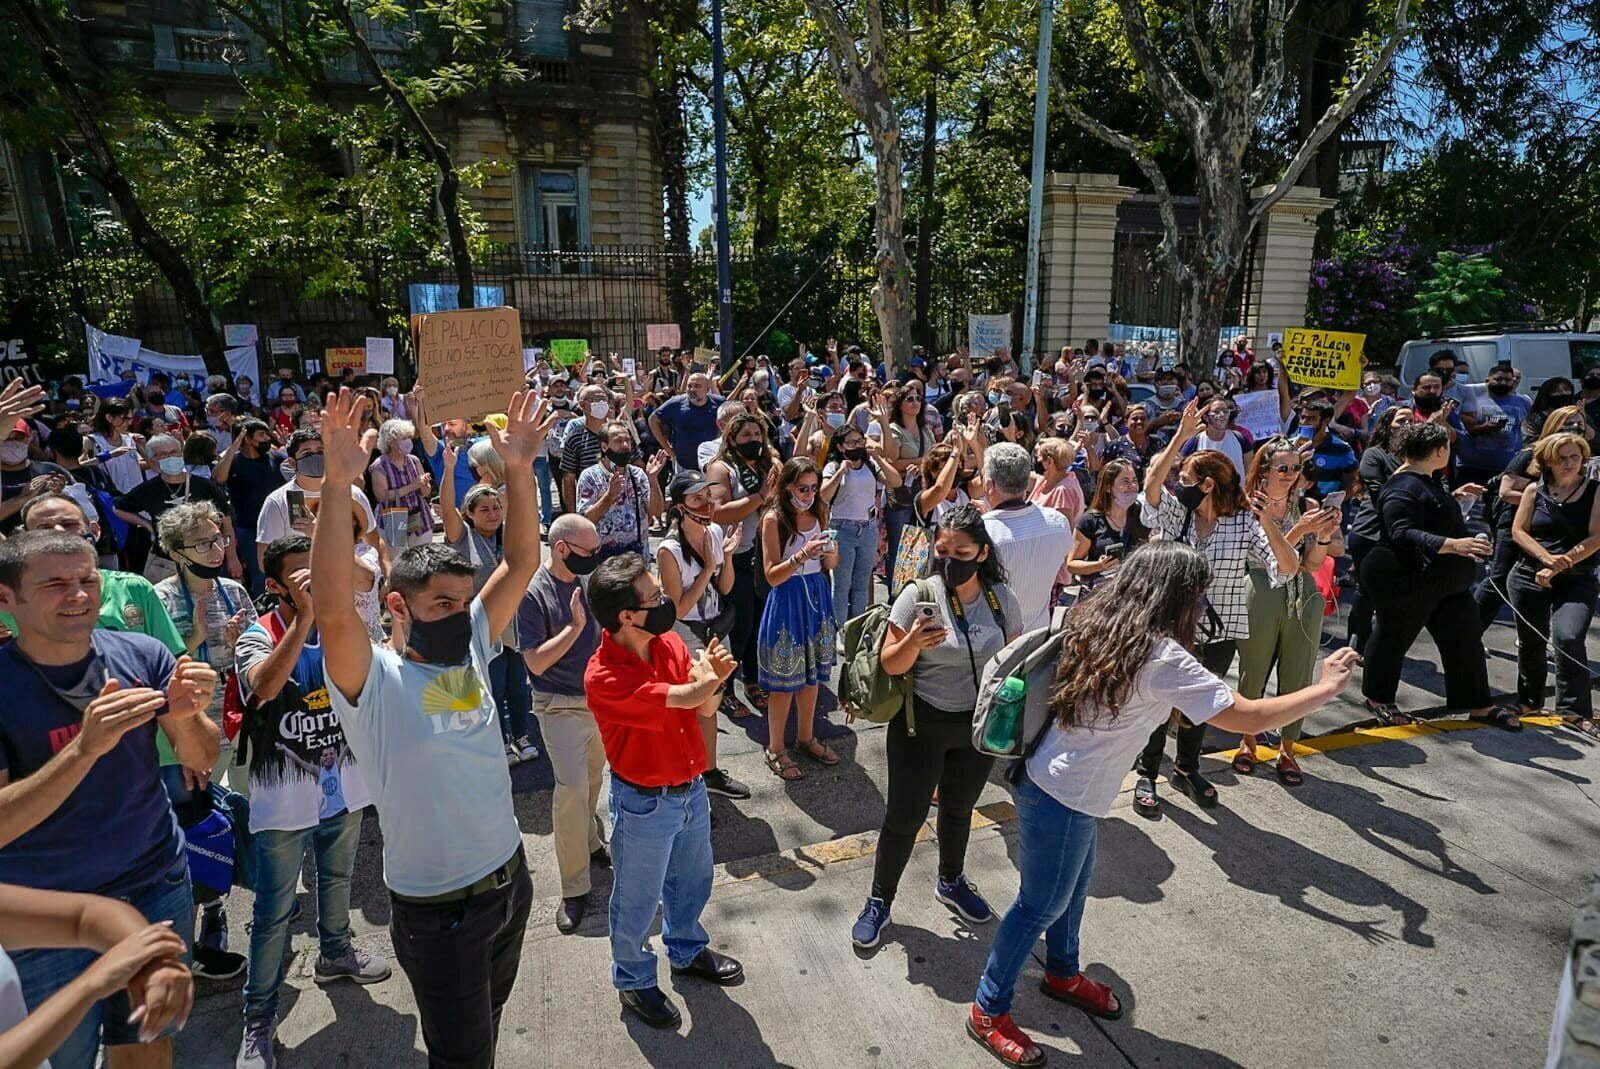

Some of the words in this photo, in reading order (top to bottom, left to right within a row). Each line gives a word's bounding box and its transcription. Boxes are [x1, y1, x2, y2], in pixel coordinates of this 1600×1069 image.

[441, 318, 510, 344] PALACIO
[1292, 332, 1305, 344] EL
[446, 347, 462, 363] NO
[464, 345, 480, 360] SE
[1300, 346, 1312, 356] ES
[1288, 355, 1345, 370] ESCUELA
[279, 710, 339, 743] Coro
